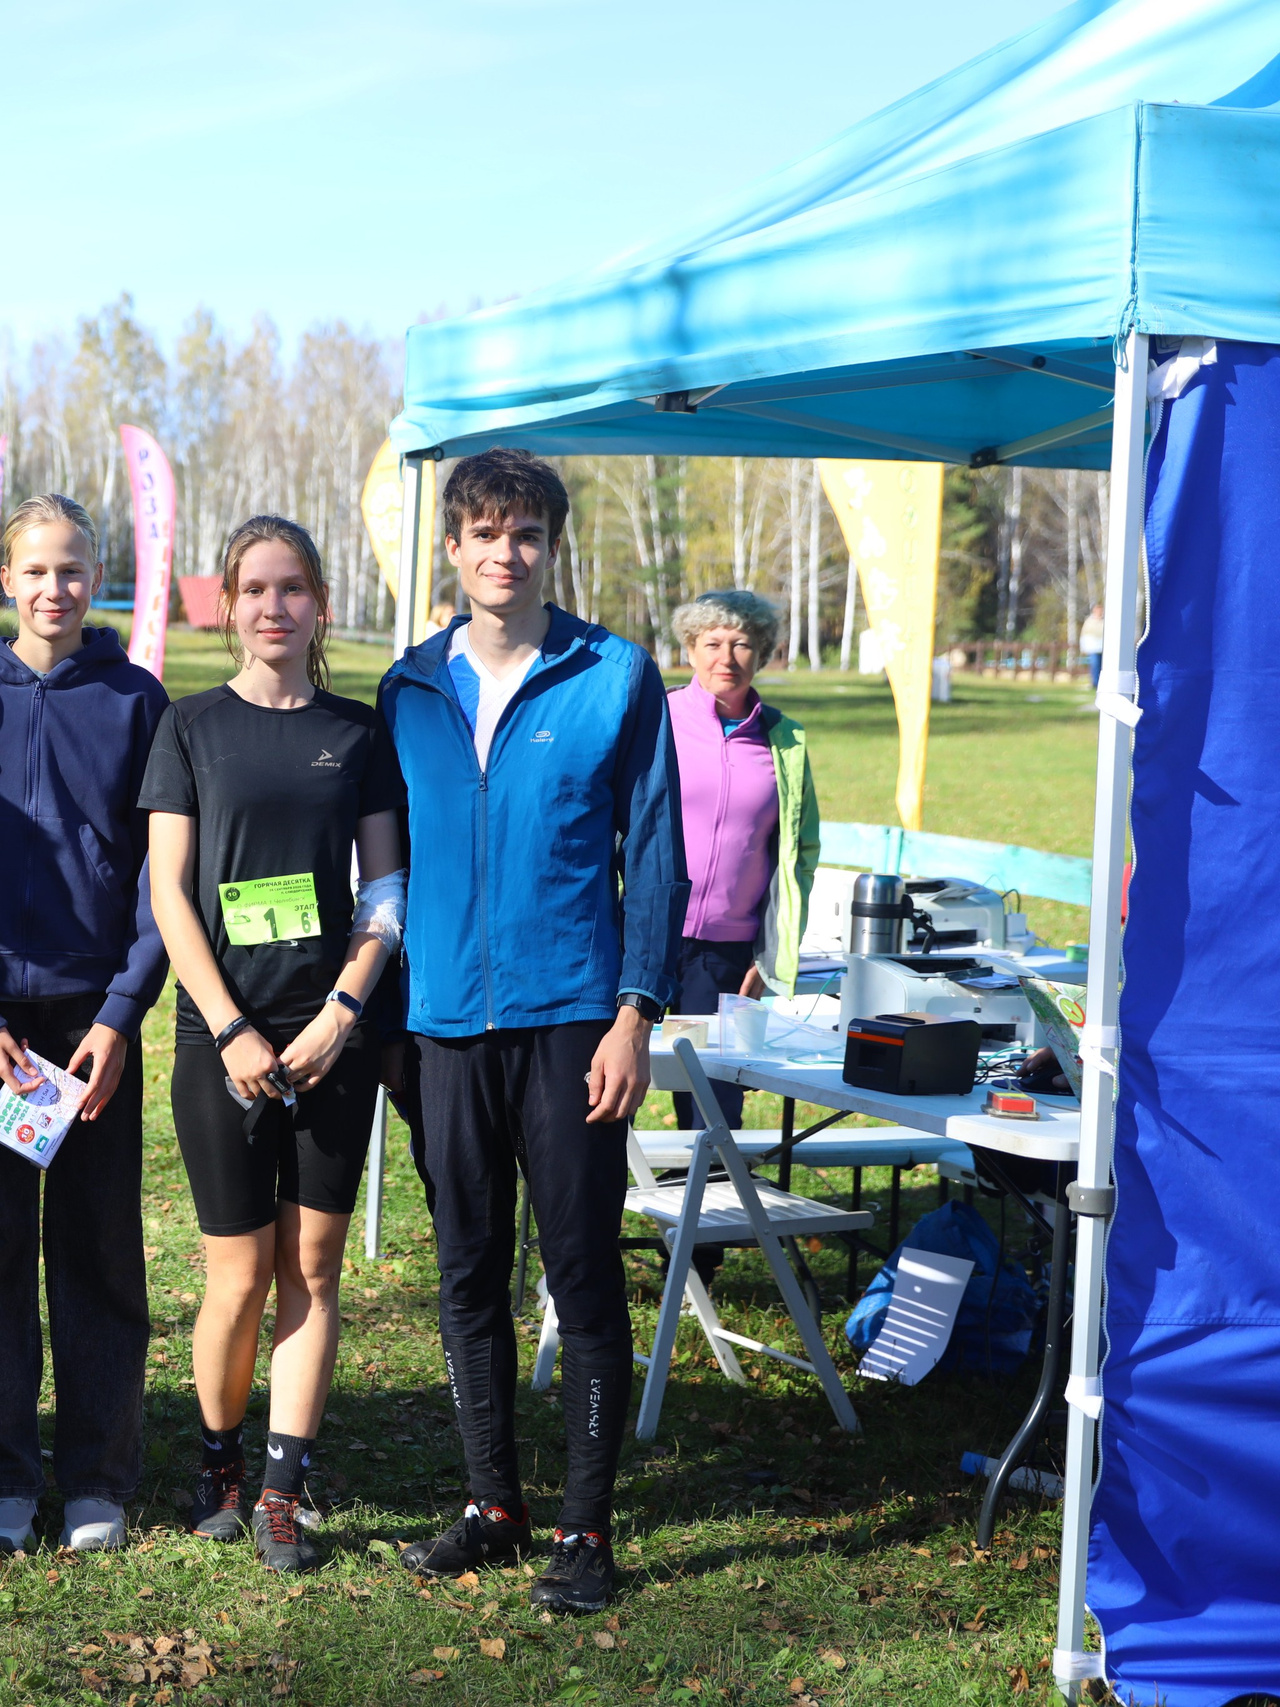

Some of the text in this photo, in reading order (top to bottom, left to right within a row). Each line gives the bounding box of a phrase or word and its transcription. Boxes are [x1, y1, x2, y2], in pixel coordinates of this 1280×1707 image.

[283, 878, 311, 886] ДЕСЯТКА
[294, 903, 315, 911] ЭТАП
[263, 907, 278, 938] 1
[301, 911, 311, 933] 6
[3, 1092, 29, 1134] ДЕСЯТК
[22, 1128, 31, 1139] 10
[589, 1378, 601, 1438] ARSWEAR
